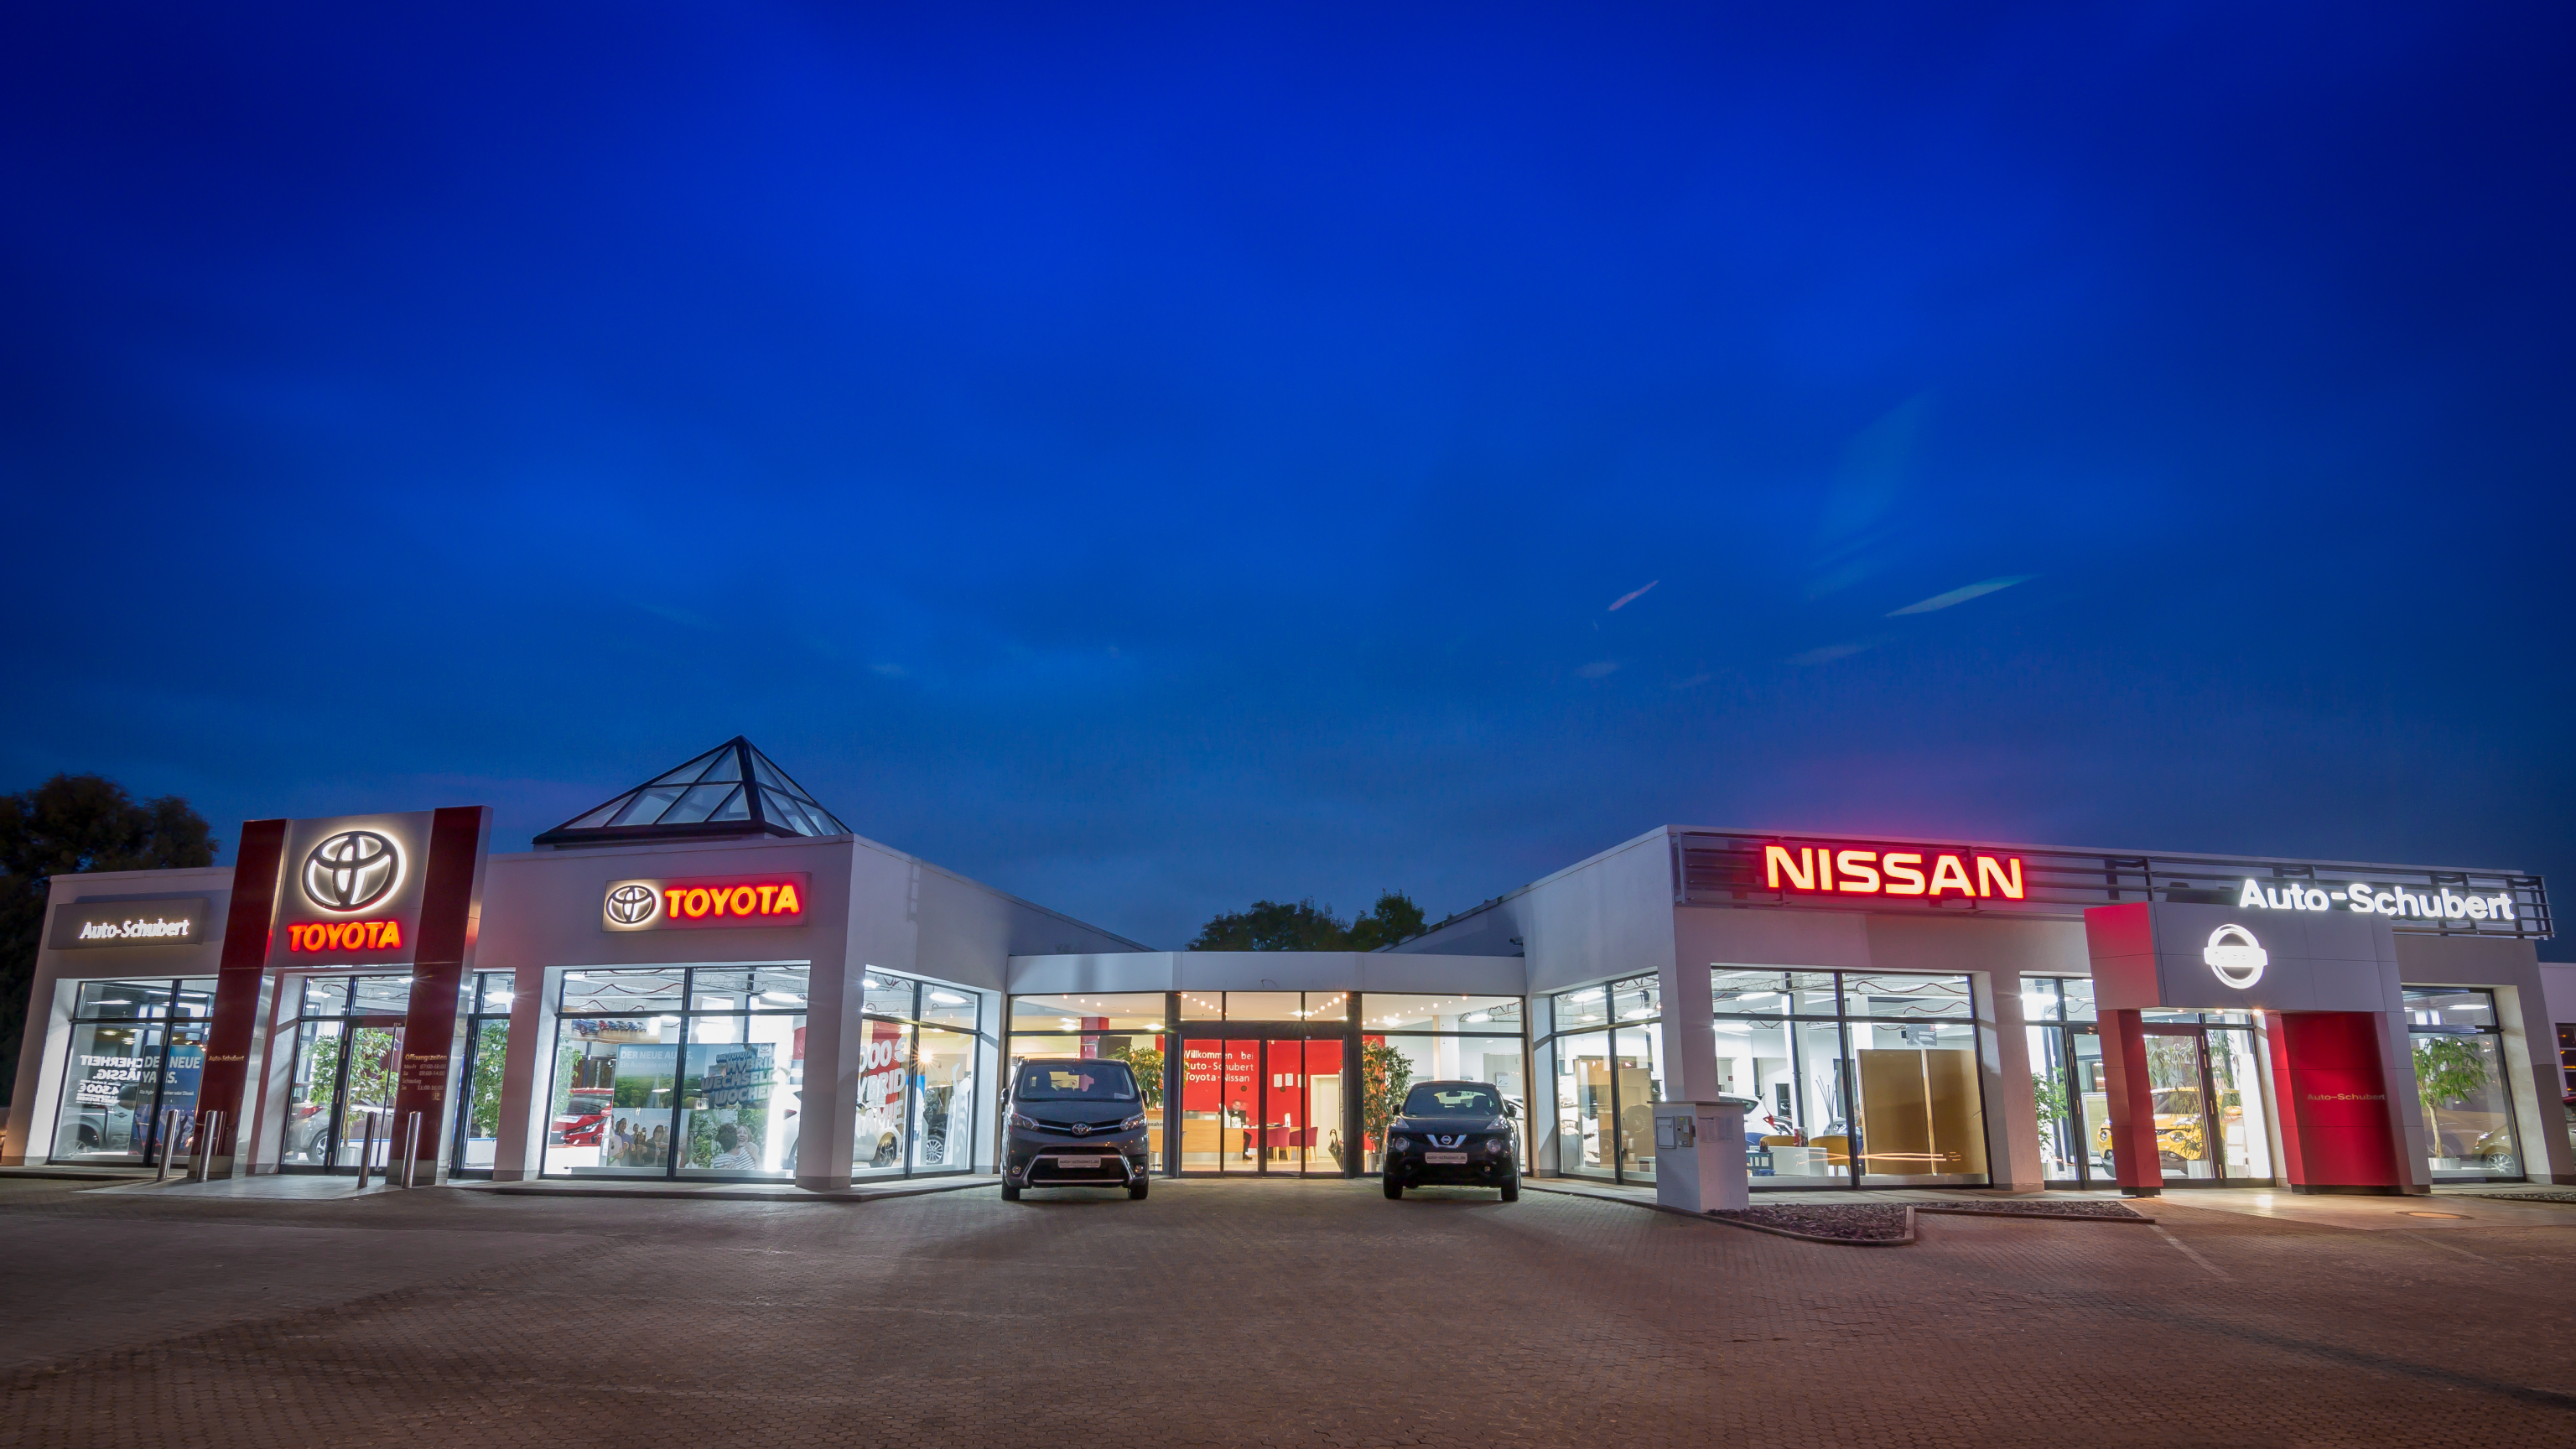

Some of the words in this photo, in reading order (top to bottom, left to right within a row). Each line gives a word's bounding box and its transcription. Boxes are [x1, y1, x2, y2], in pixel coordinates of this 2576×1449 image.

[1765, 845, 2023, 900] NISSAN
[664, 885, 801, 918] TOYOTA
[2239, 879, 2515, 920] Auto-Schubert
[78, 918, 190, 939] Auto-Schubert
[288, 921, 402, 952] TOYOTA
[144, 1056, 160, 1068] DE
[169, 1056, 201, 1069] NEUE
[621, 1051, 638, 1059] DER
[640, 1051, 662, 1059] NEUE
[665, 1051, 693, 1060] AUS.
[726, 1056, 776, 1073] HYBRID
[728, 1051, 752, 1062] TOYOTA
[859, 1040, 893, 1073] 000
[895, 1036, 907, 1062] €
[1241, 1051, 1254, 1060] bei
[143, 1071, 178, 1084] YAIS.
[857, 1067, 906, 1104] YBRID
